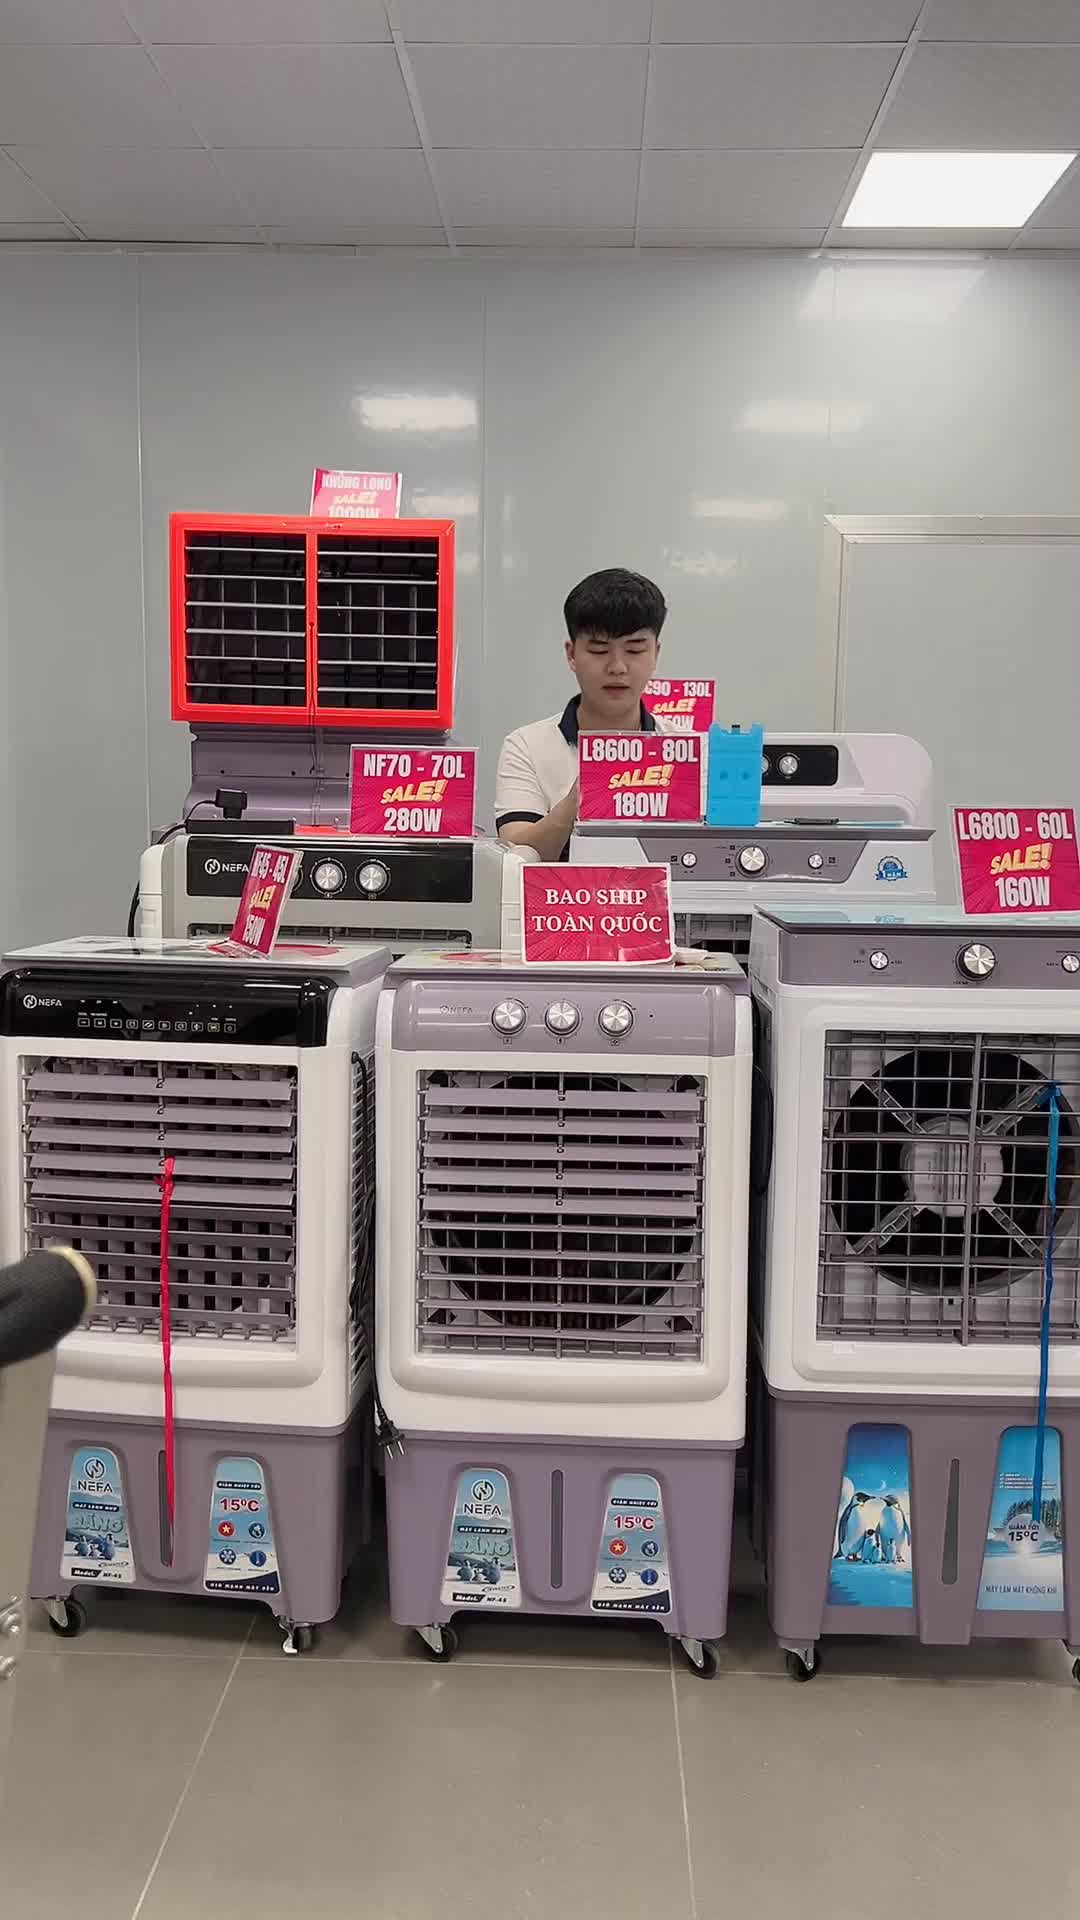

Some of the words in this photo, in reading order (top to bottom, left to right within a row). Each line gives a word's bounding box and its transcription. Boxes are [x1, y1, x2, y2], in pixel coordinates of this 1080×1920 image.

[683, 681, 712, 698] 130L
[652, 697, 697, 714] SALE!
[582, 738, 643, 762] L8600
[662, 738, 698, 762] 80L
[363, 753, 412, 778] NF70
[431, 754, 466, 778] 70L
[608, 763, 674, 790] SALE!
[380, 778, 449, 804] SALE!
[613, 792, 669, 817] 180W
[383, 807, 443, 833] 280W
[957, 811, 1020, 841] L6800
[1037, 811, 1073, 840] 60L
[222, 863, 250, 873] NEFA
[989, 842, 1054, 875] SALE!
[545, 888, 591, 905] BAO
[596, 888, 648, 906] SHIP
[994, 876, 1050, 908] 160W
[531, 911, 595, 933] TOÀN
[600, 911, 663, 937] QUỐC
[38, 998, 63, 1008] NEFA
[78, 1480, 113, 1493] NEFA
[463, 1503, 502, 1516] NEFA
